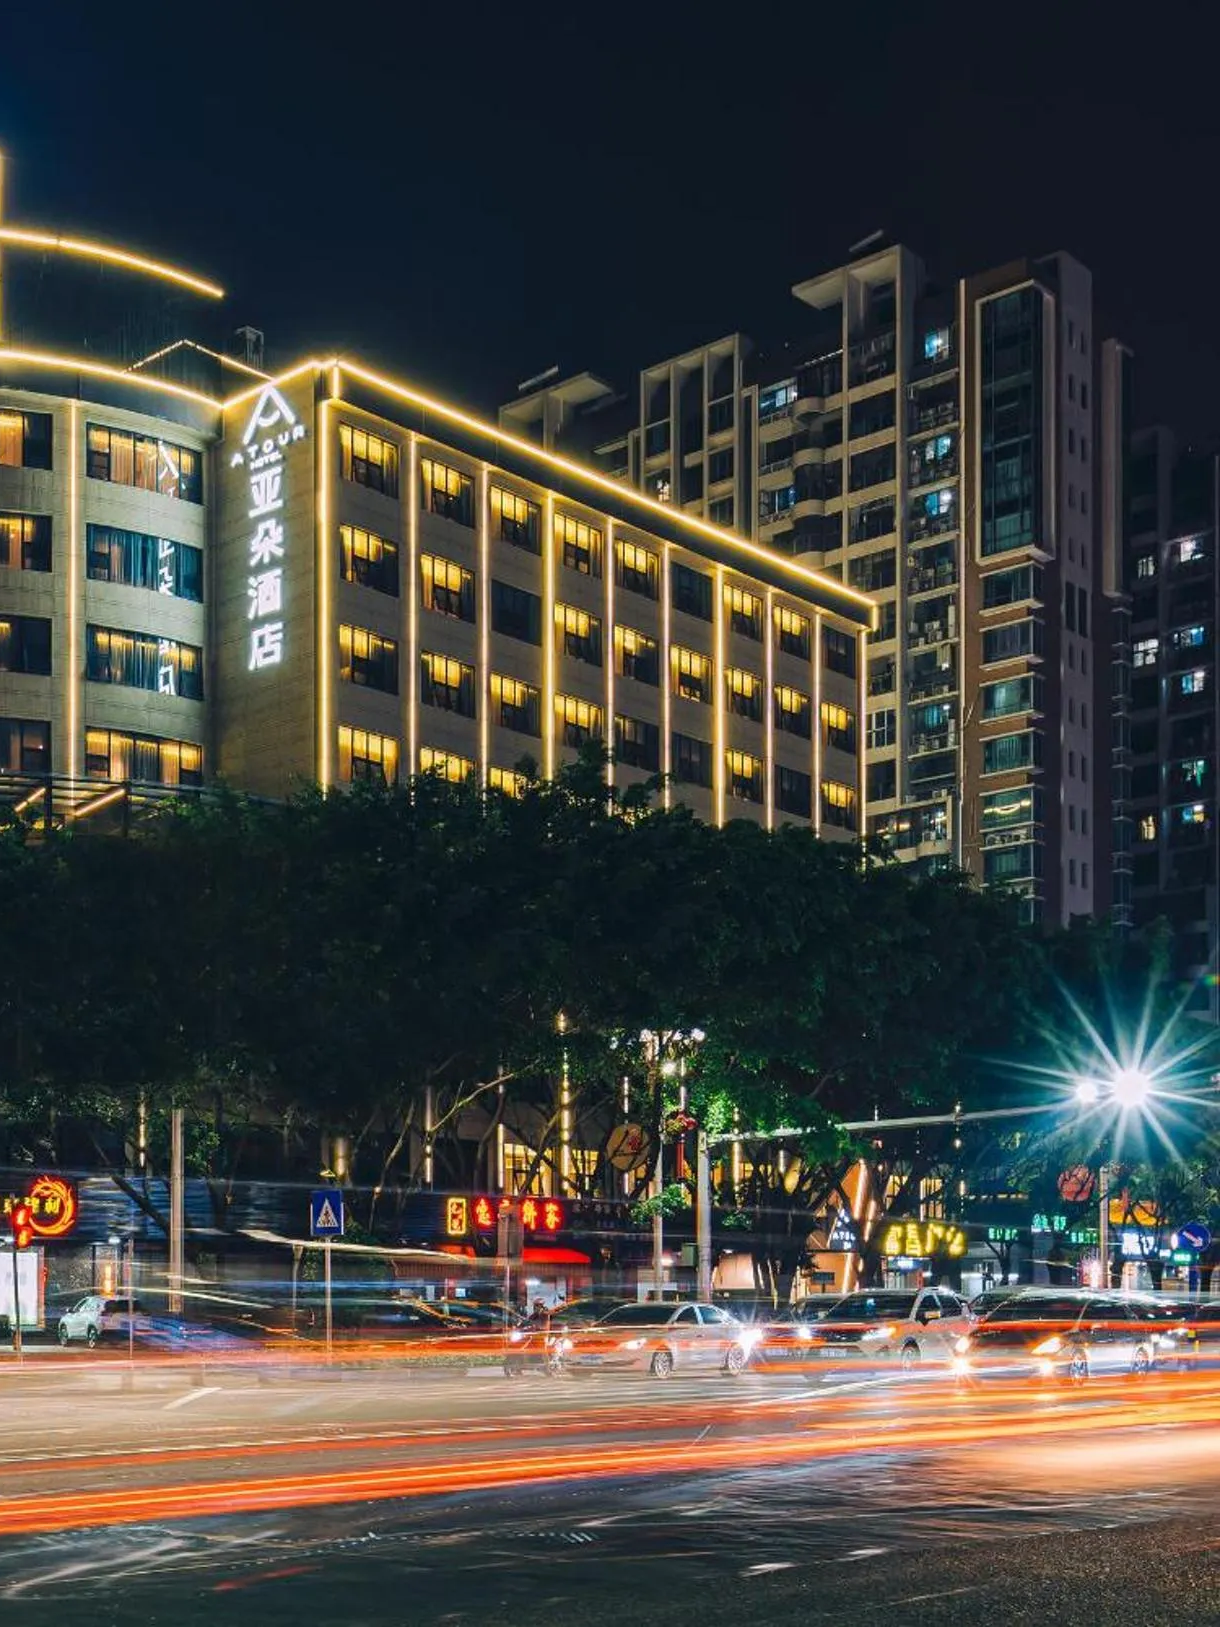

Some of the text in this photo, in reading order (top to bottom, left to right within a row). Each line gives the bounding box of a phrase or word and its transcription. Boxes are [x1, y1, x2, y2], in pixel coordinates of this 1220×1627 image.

[230, 424, 305, 468] ATOUR
[247, 465, 284, 671] 亚朵酒店
